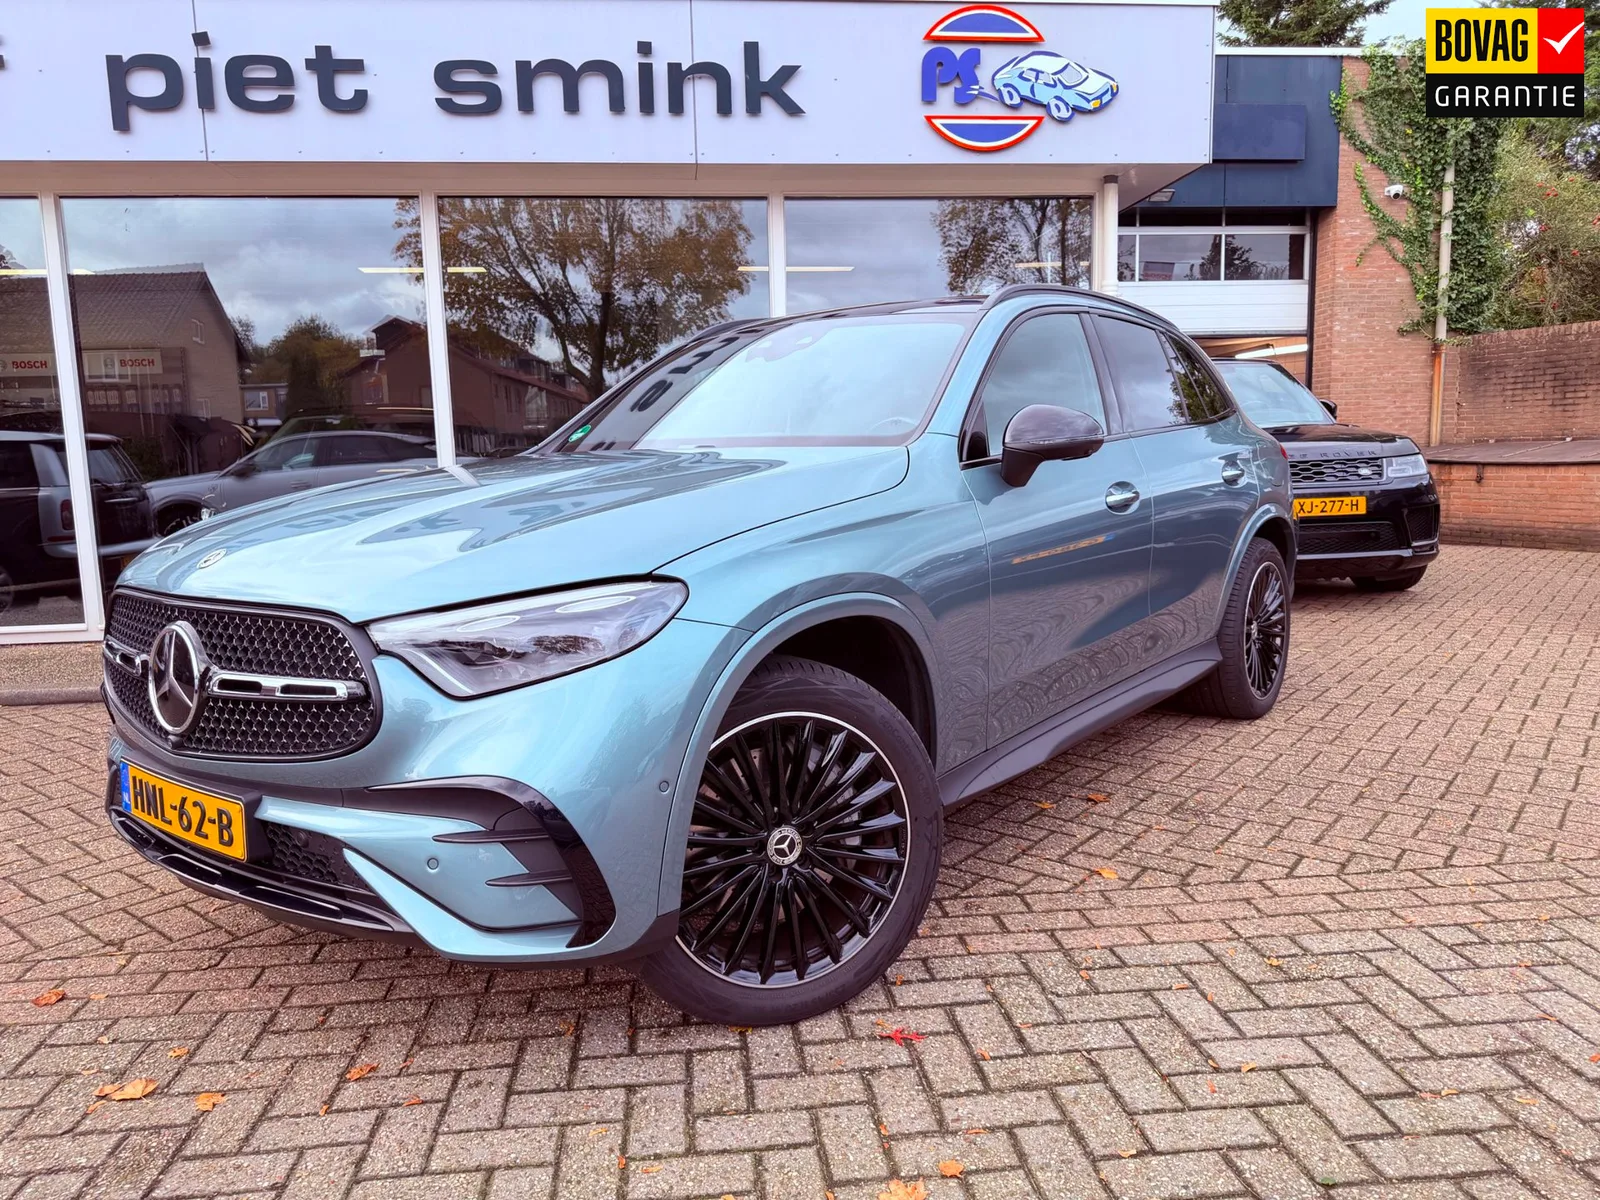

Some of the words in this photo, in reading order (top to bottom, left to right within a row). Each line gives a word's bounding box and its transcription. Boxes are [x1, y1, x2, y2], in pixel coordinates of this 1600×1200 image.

[105, 31, 369, 132] piet
[433, 40, 807, 117] smink
[12, 360, 48, 369] BOSCH
[119, 358, 155, 367] BOSCH
[1319, 450, 1377, 458] ROVER
[1298, 499, 1359, 514] XJ-277-H
[131, 775, 234, 847] HNL-62-B
